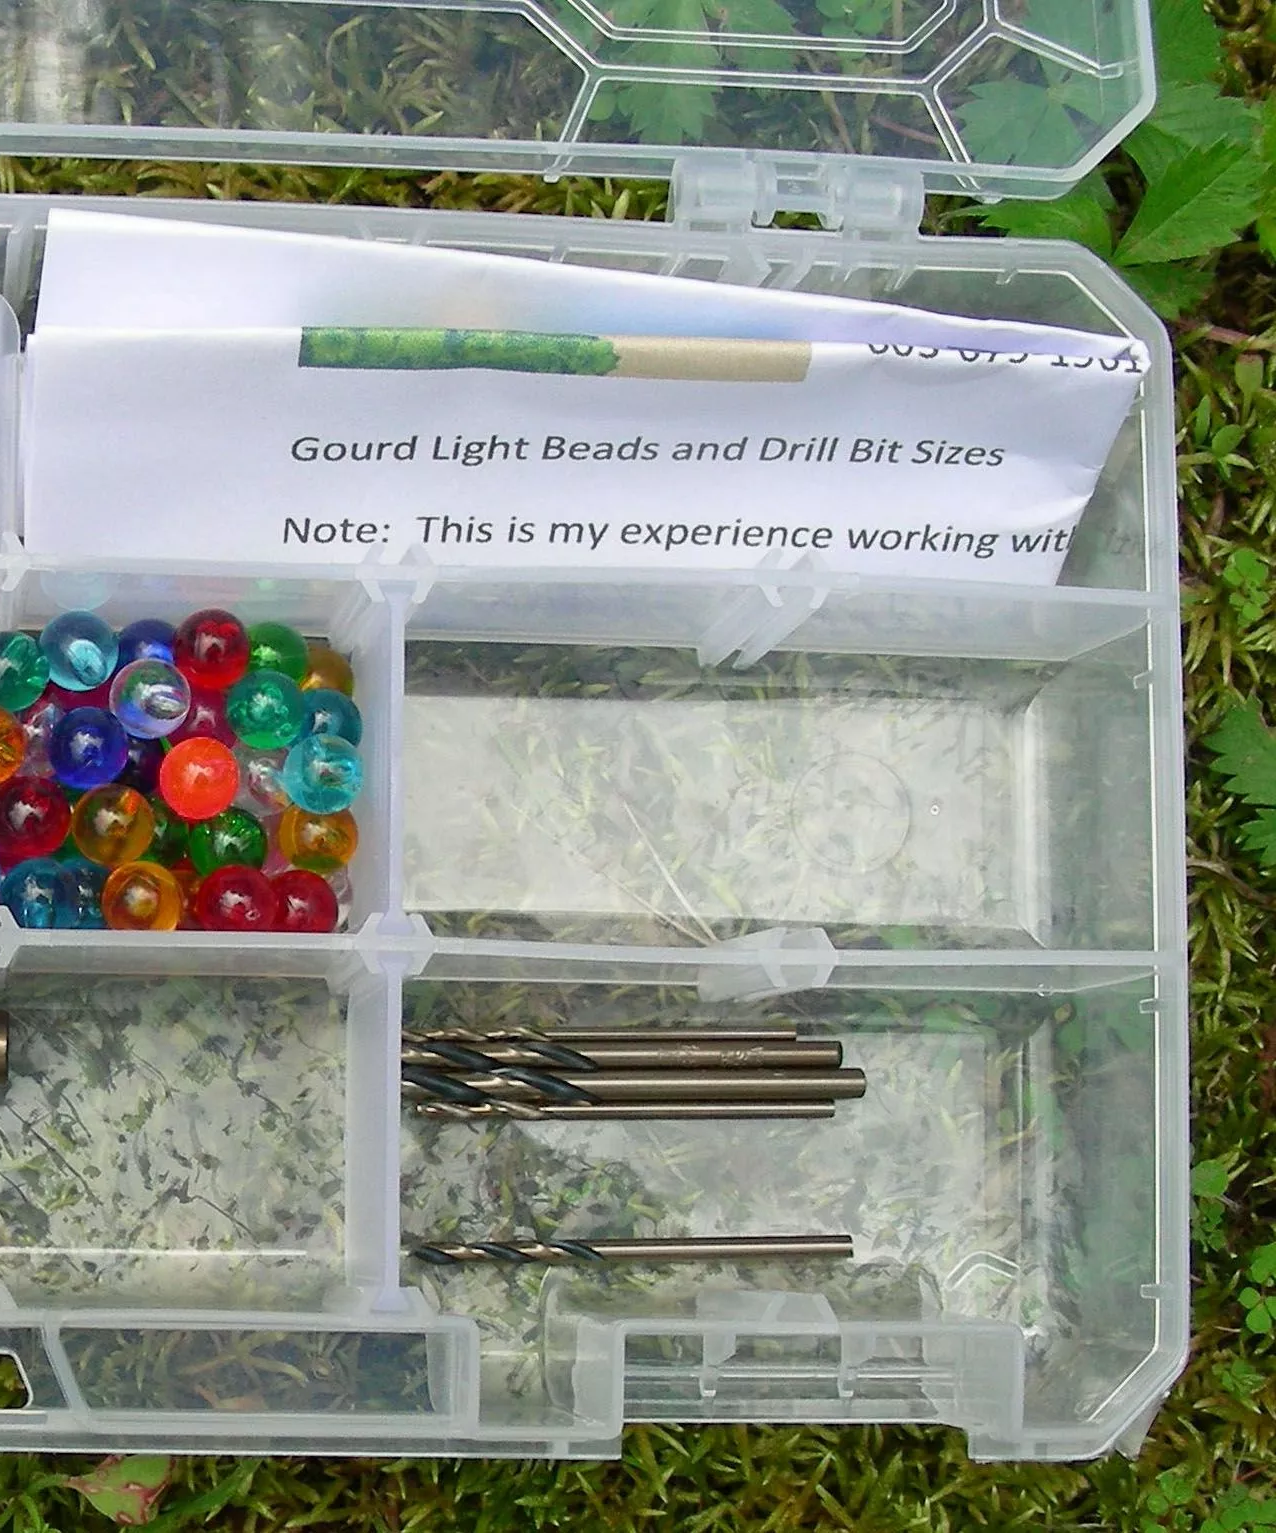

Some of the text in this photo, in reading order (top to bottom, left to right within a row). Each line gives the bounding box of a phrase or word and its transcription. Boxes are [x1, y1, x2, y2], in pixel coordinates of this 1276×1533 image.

[291, 435, 1006, 467] Gourd Light Beads and Drill Bit Sizes
[283, 517, 390, 544] Note:
[416, 515, 493, 544] This
[508, 516, 535, 544] is
[549, 522, 609, 551] my
[621, 519, 833, 552] experience
[848, 524, 1000, 559] working
